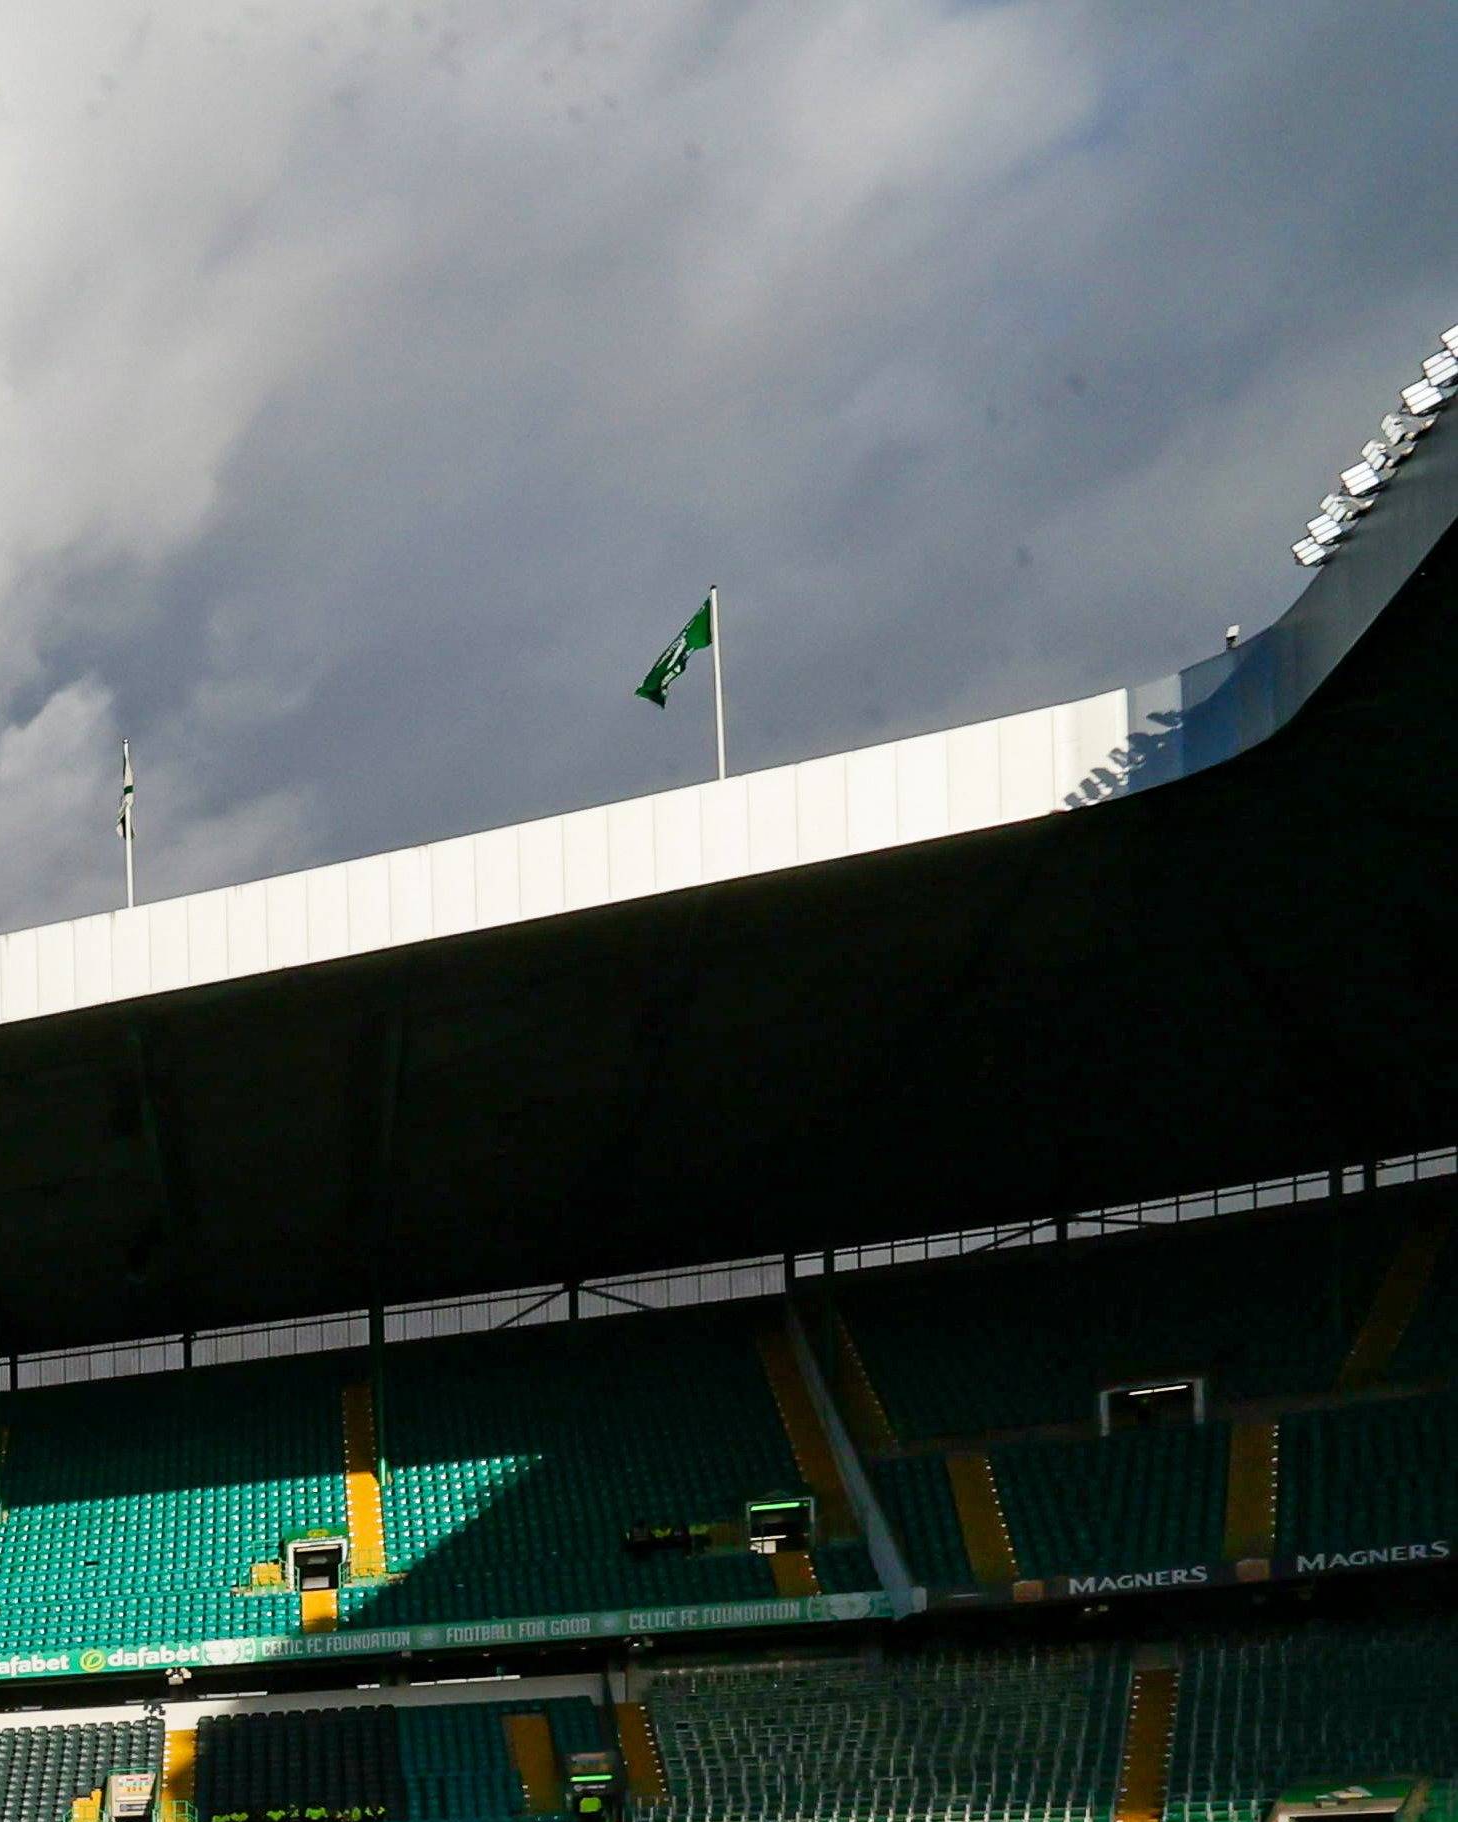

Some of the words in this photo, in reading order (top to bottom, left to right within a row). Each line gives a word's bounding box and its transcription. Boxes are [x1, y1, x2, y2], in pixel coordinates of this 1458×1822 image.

[1296, 1540, 1450, 1573] MAGNERS
[1068, 1565, 1208, 1594] MAGNERS
[629, 1607, 677, 1630] CELTIC
[680, 1606, 698, 1627] FC
[107, 1644, 200, 1667] dafabet
